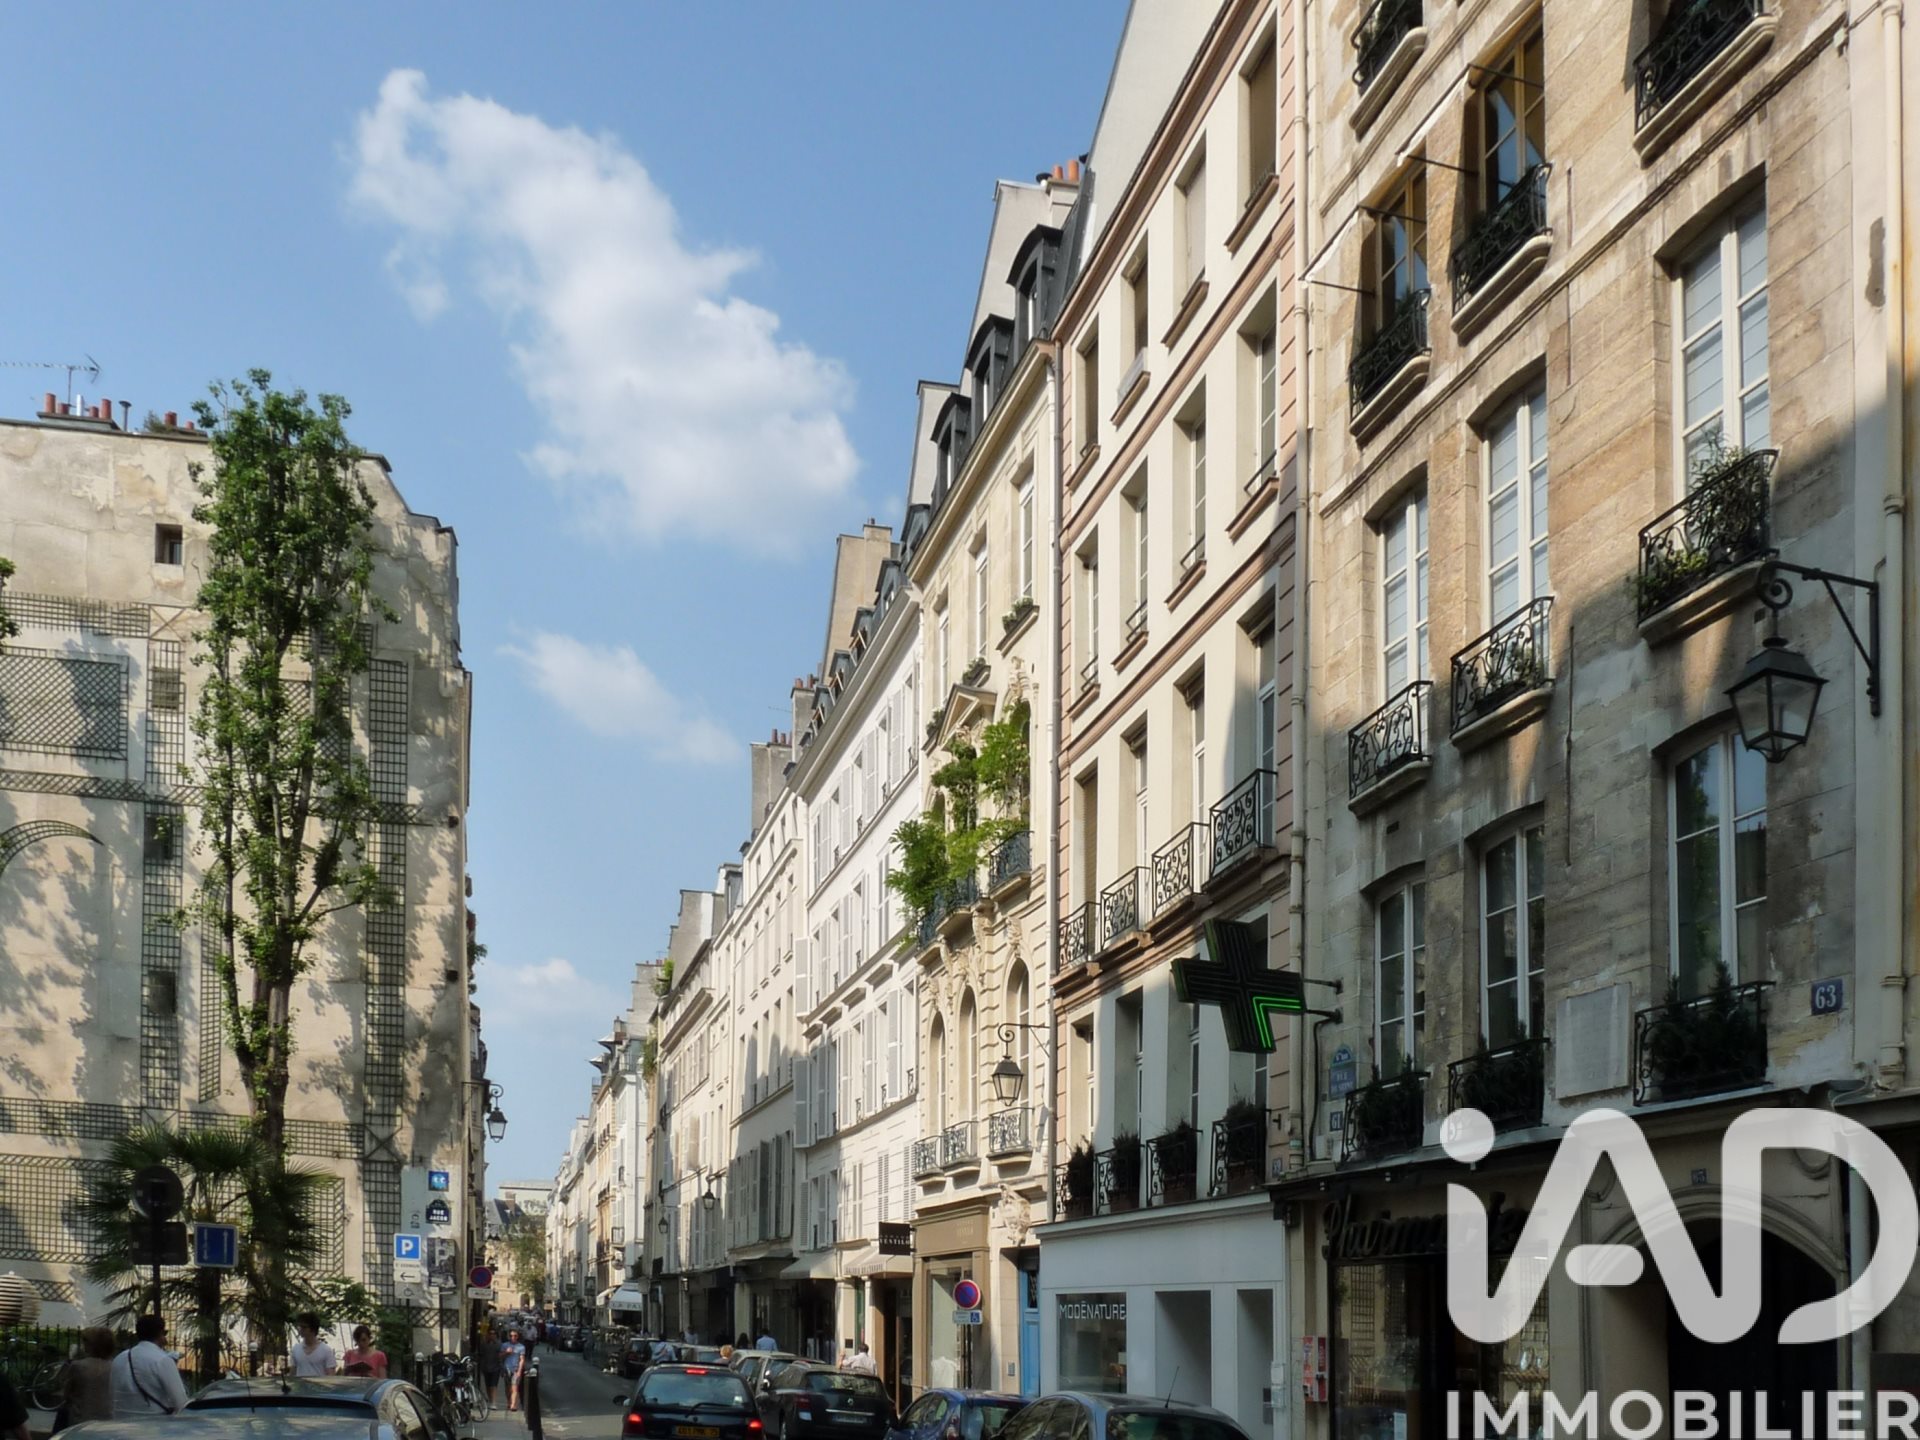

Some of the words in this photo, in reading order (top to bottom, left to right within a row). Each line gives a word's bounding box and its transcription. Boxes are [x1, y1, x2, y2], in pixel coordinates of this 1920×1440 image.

[1815, 984, 1836, 1009] 63
[1331, 1113, 1342, 1130] 61
[402, 1239, 414, 1255] P
